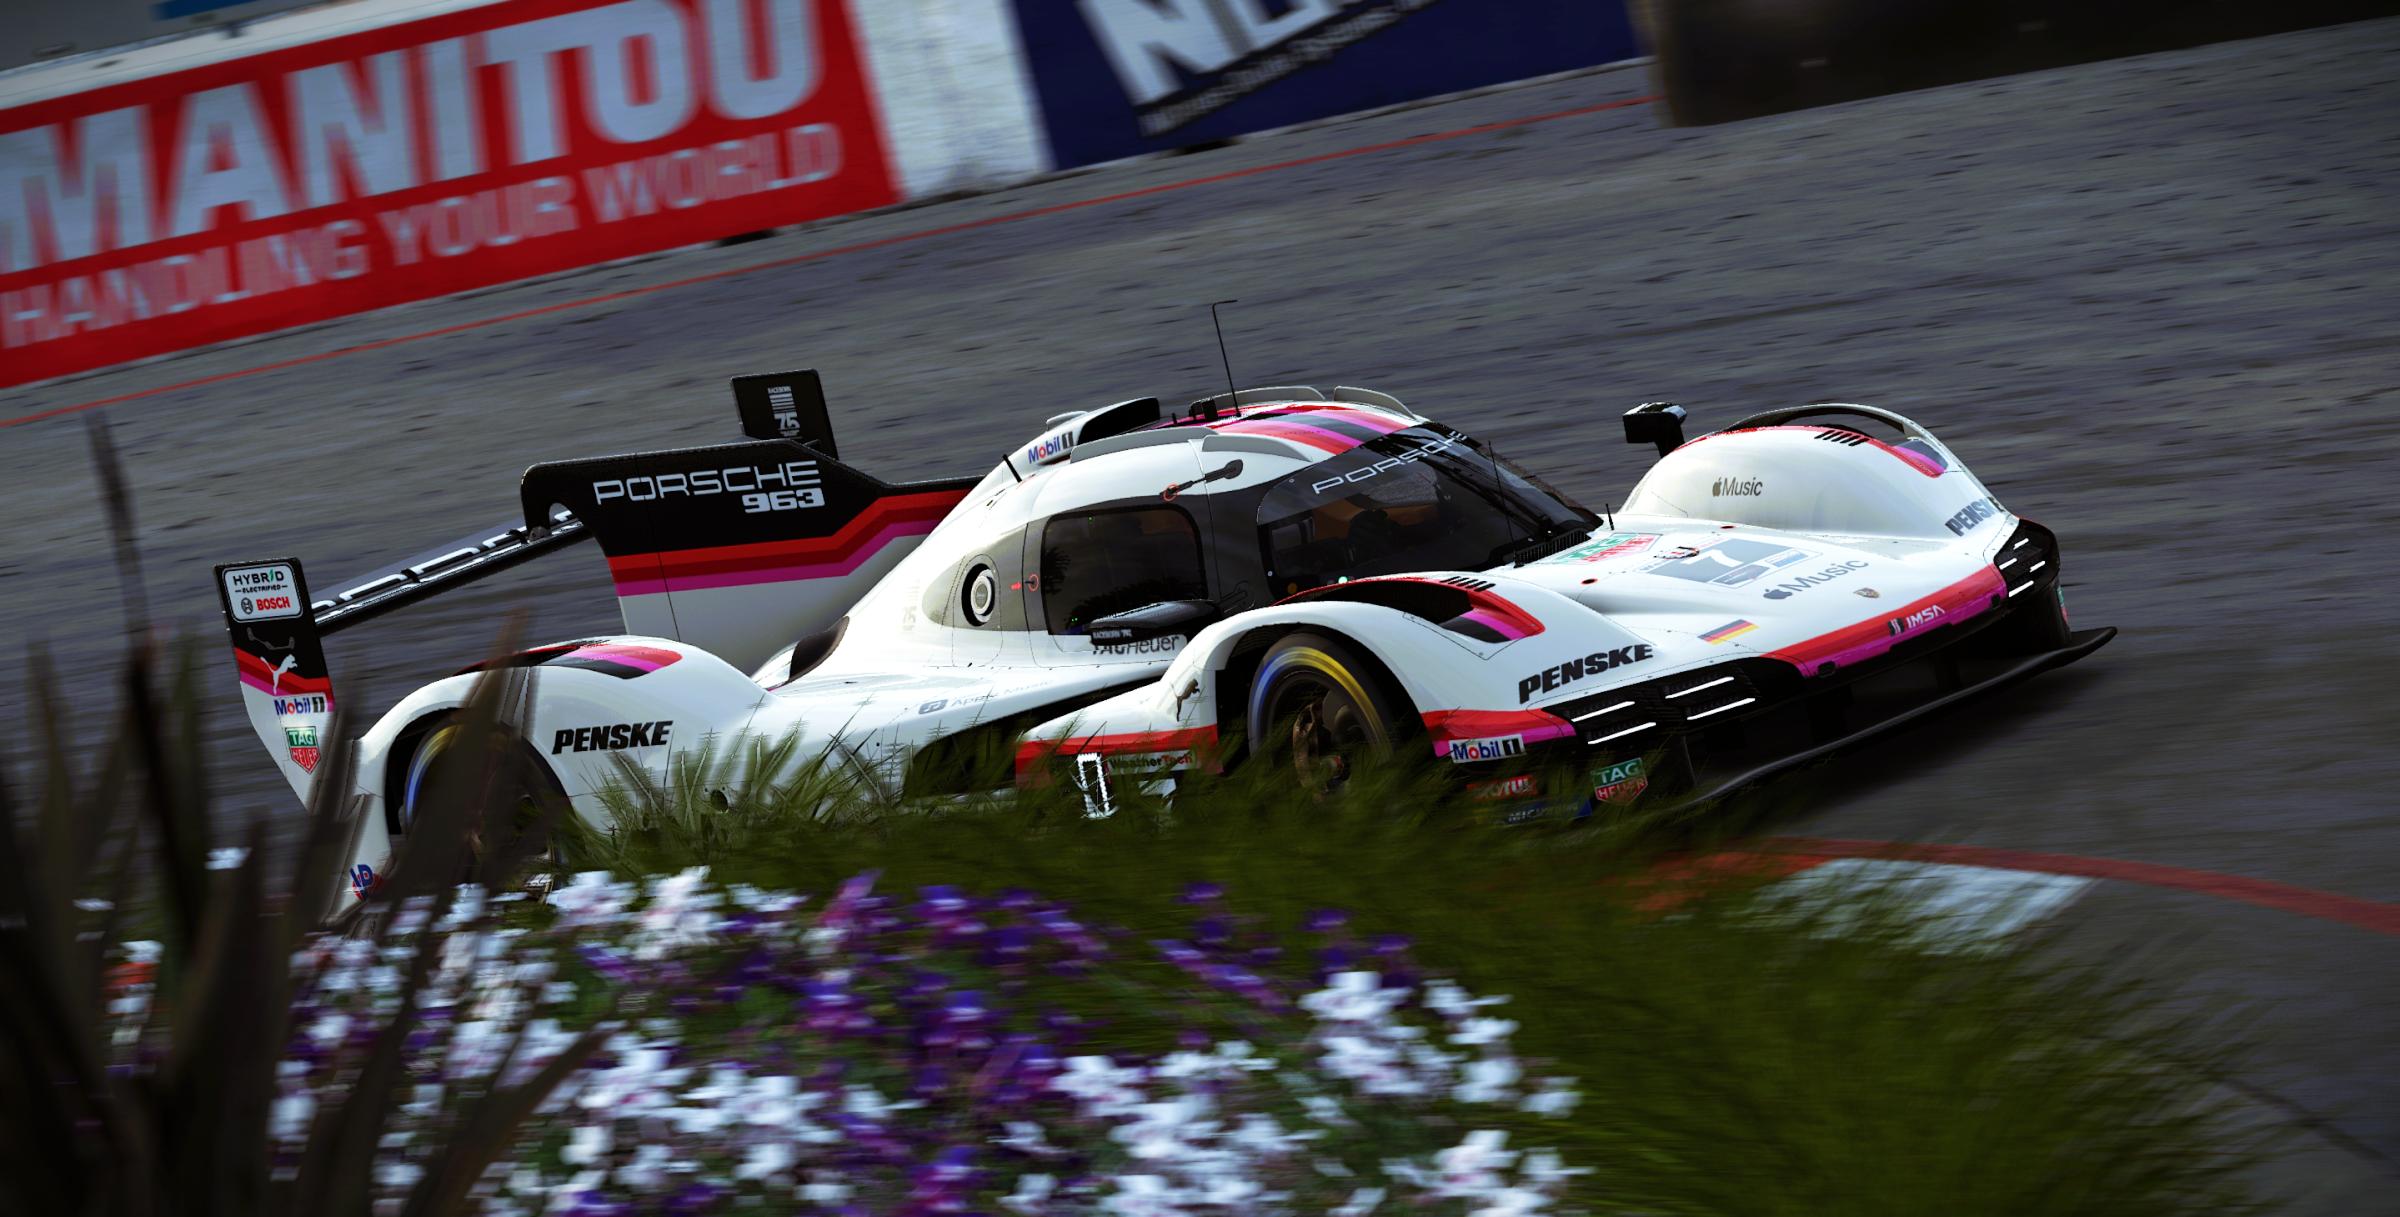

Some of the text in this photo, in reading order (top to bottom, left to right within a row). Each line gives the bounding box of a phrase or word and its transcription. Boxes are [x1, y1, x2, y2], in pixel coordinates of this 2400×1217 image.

[0, 0, 828, 274] MANITOU
[1, 122, 843, 350] HANDLING YOUR WORLD
[774, 411, 801, 431] 75
[1028, 435, 1062, 464] Mobil
[1311, 430, 1468, 495] PORSCHE
[592, 460, 822, 506] PORSCHE
[1722, 476, 1763, 497] Music
[742, 487, 825, 514] 963
[233, 569, 284, 585] HYBRID
[1780, 559, 1869, 592] Music
[242, 584, 281, 594] ELECTRIFIED
[256, 596, 291, 611] BOSCH
[1906, 604, 1945, 629] IMSA
[1519, 644, 1653, 705] PENSKE
[274, 697, 311, 716] Mobil
[289, 731, 314, 746] TAG
[551, 720, 673, 755] PENSKE
[292, 749, 318, 769] HEUER
[1452, 741, 1501, 760] Mobil
[1597, 762, 1640, 784] TAG
